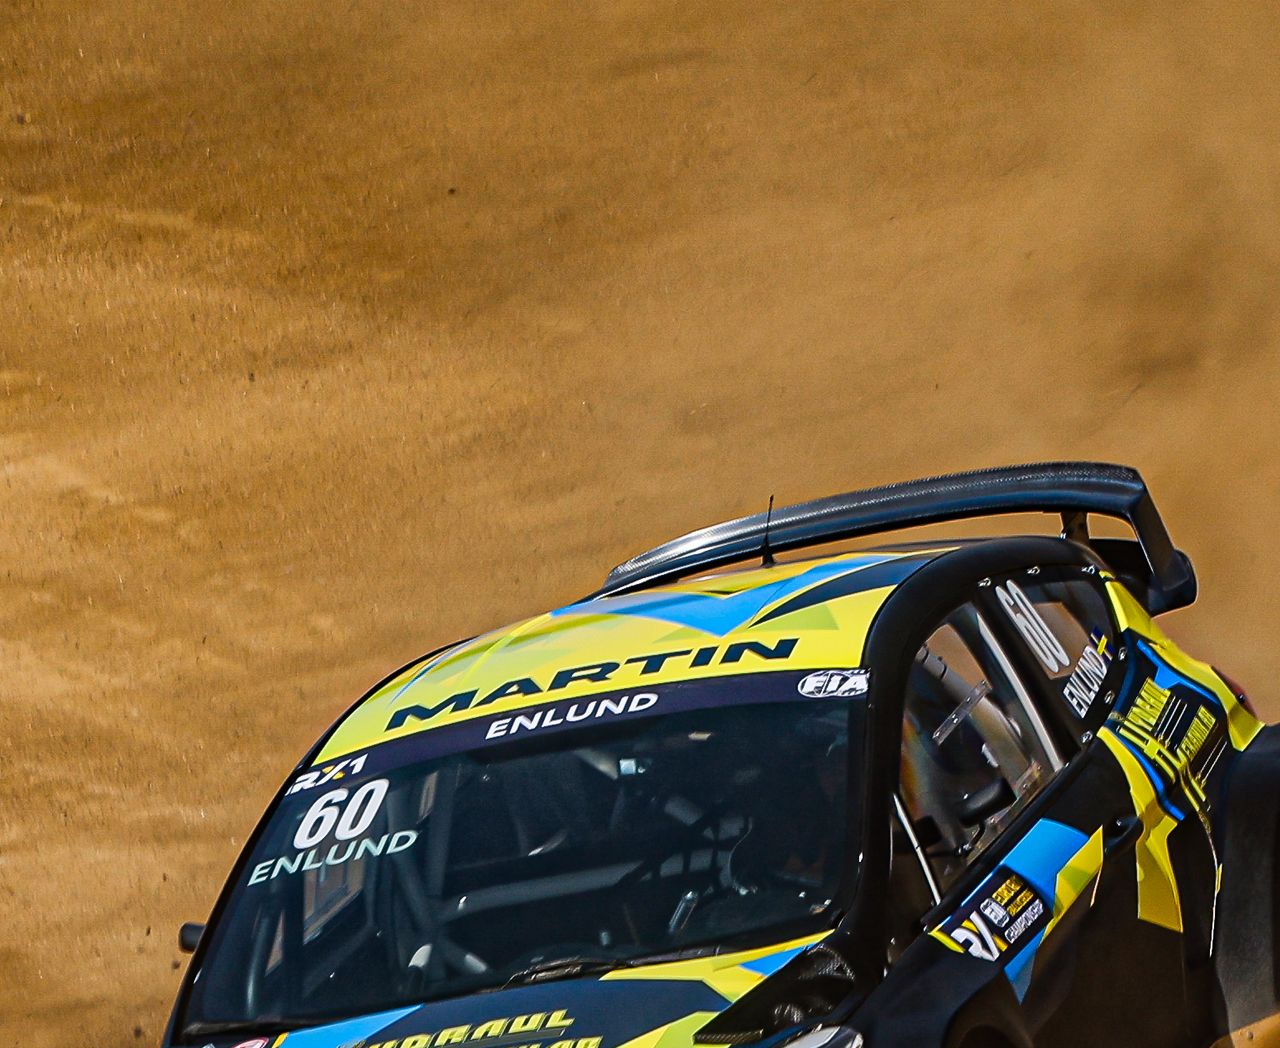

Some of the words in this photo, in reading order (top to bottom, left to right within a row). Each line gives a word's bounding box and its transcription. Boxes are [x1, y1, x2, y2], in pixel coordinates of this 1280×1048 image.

[995, 579, 1070, 673] 60
[383, 637, 801, 732] MARTIN
[801, 673, 869, 695] FIA
[1063, 645, 1108, 719] ENLUND
[484, 692, 660, 741] ENLUND
[284, 753, 368, 796] RX1
[293, 778, 390, 850] 60
[246, 829, 419, 887] ENLUND
